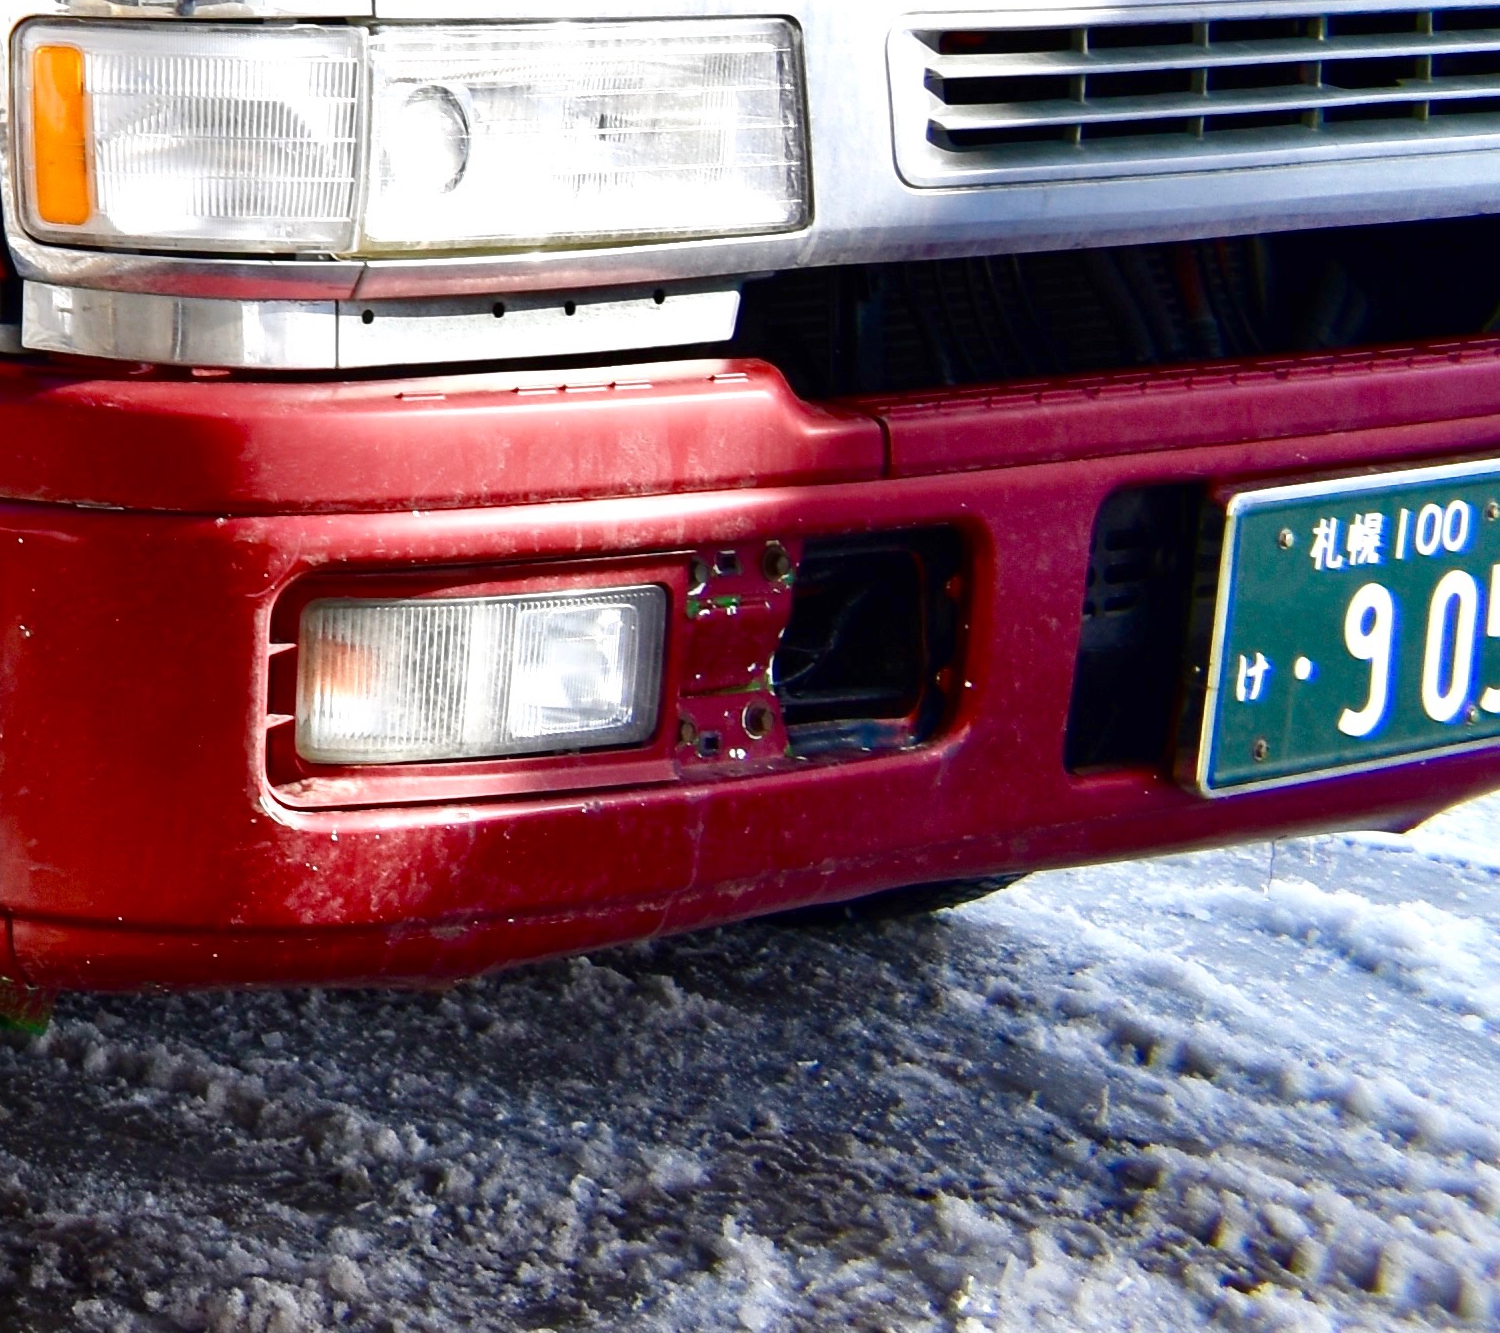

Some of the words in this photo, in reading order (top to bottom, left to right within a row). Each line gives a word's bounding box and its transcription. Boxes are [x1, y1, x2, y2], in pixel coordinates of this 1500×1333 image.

[1309, 512, 1384, 571] 札幌
[1394, 499, 1471, 561] 100
[1235, 652, 1270, 702] け
